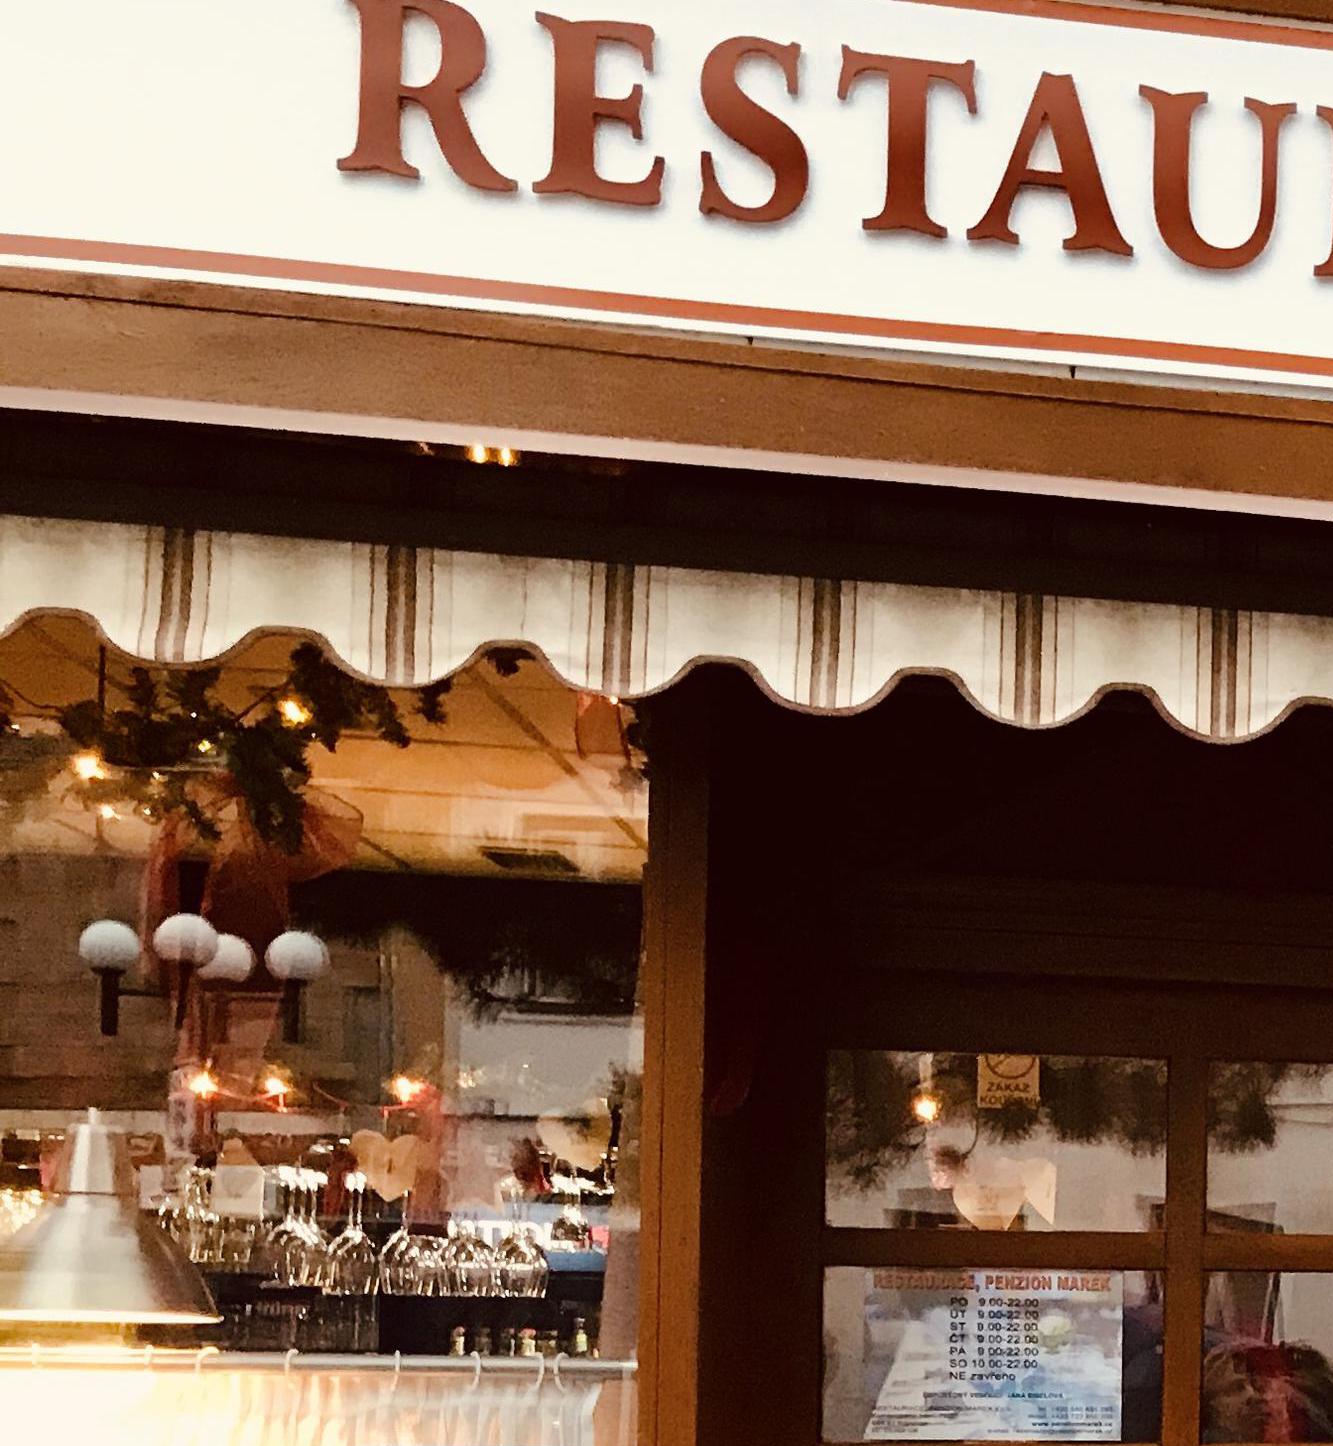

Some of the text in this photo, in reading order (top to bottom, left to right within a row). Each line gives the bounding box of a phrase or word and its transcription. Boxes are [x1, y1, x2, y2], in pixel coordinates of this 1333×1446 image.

[985, 1275, 1052, 1291] PENZION
[1057, 1275, 1112, 1292] MAREK
[950, 1297, 968, 1307] PO
[949, 1359, 967, 1368] SO
[949, 1371, 1016, 1381] NE zavřeno
